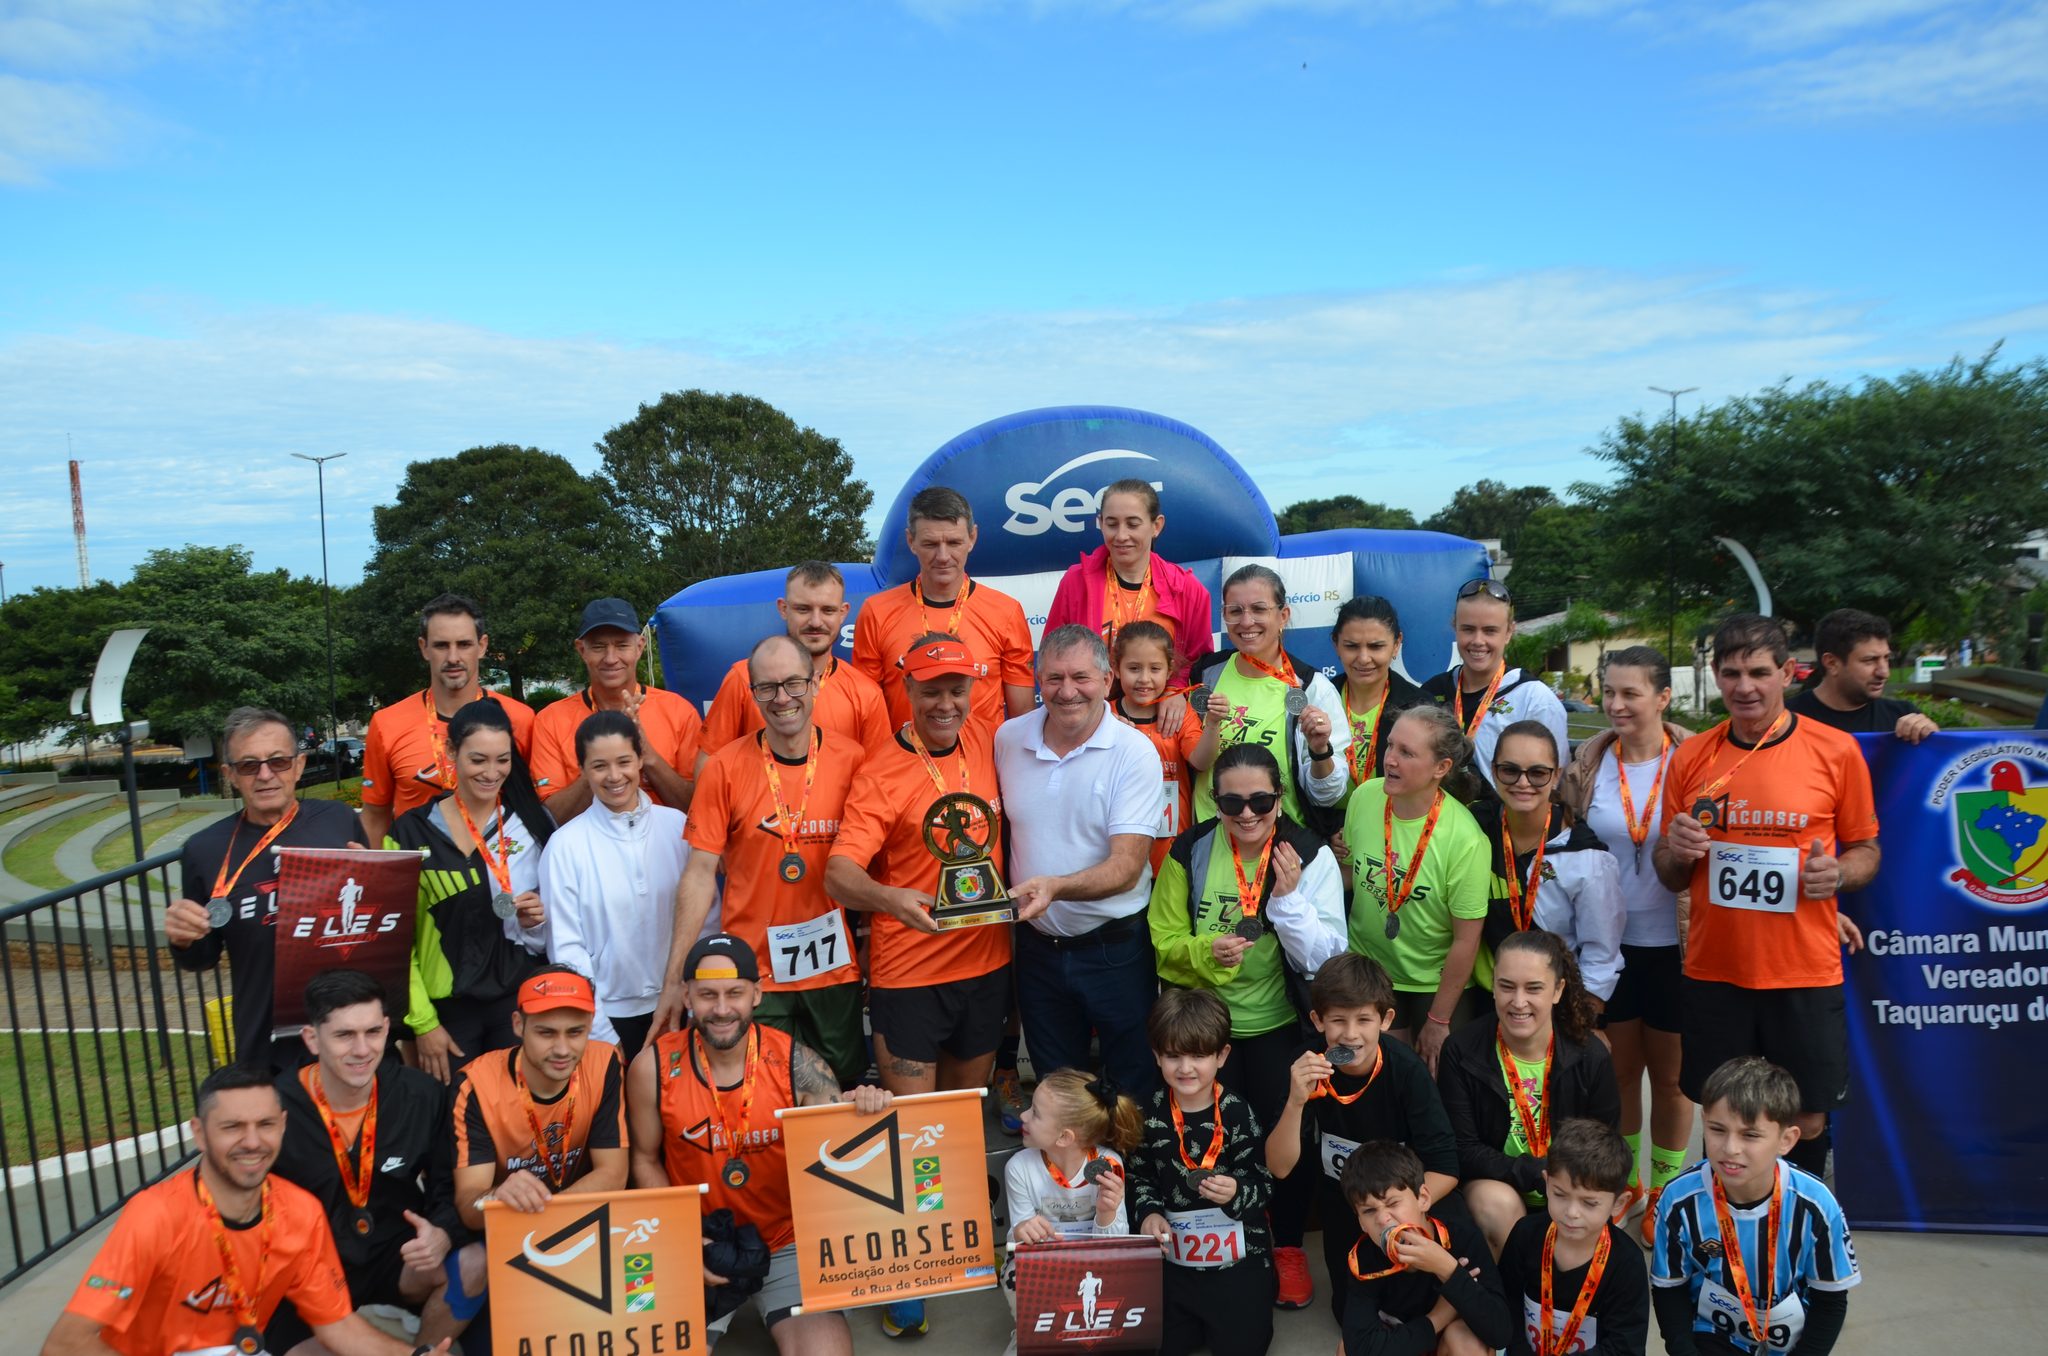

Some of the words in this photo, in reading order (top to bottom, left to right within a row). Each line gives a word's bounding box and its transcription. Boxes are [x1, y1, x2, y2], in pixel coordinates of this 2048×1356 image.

[1324, 590, 1340, 601] RS
[1932, 768, 1958, 806] PODER
[1957, 745, 2033, 771] LEGISLATIVO
[1728, 809, 1809, 829] ACORSEB
[1718, 866, 1785, 905] 649
[781, 932, 837, 977] 717
[1868, 929, 1980, 956] Câmara
[1921, 961, 2048, 989] Vereador
[1872, 999, 2020, 1031] Taquaruçu
[2027, 995, 2048, 1022] d
[819, 1219, 980, 1269] ACORSEB
[1172, 1231, 1239, 1263] 1221
[818, 1264, 886, 1284] Associação
[888, 1261, 911, 1275] dos
[913, 1253, 982, 1271] Corredores
[851, 1285, 866, 1297] de
[870, 1283, 893, 1295] Rua
[896, 1279, 911, 1291] de
[915, 1272, 953, 1288] Seberi
[1711, 1309, 1791, 1349] 969
